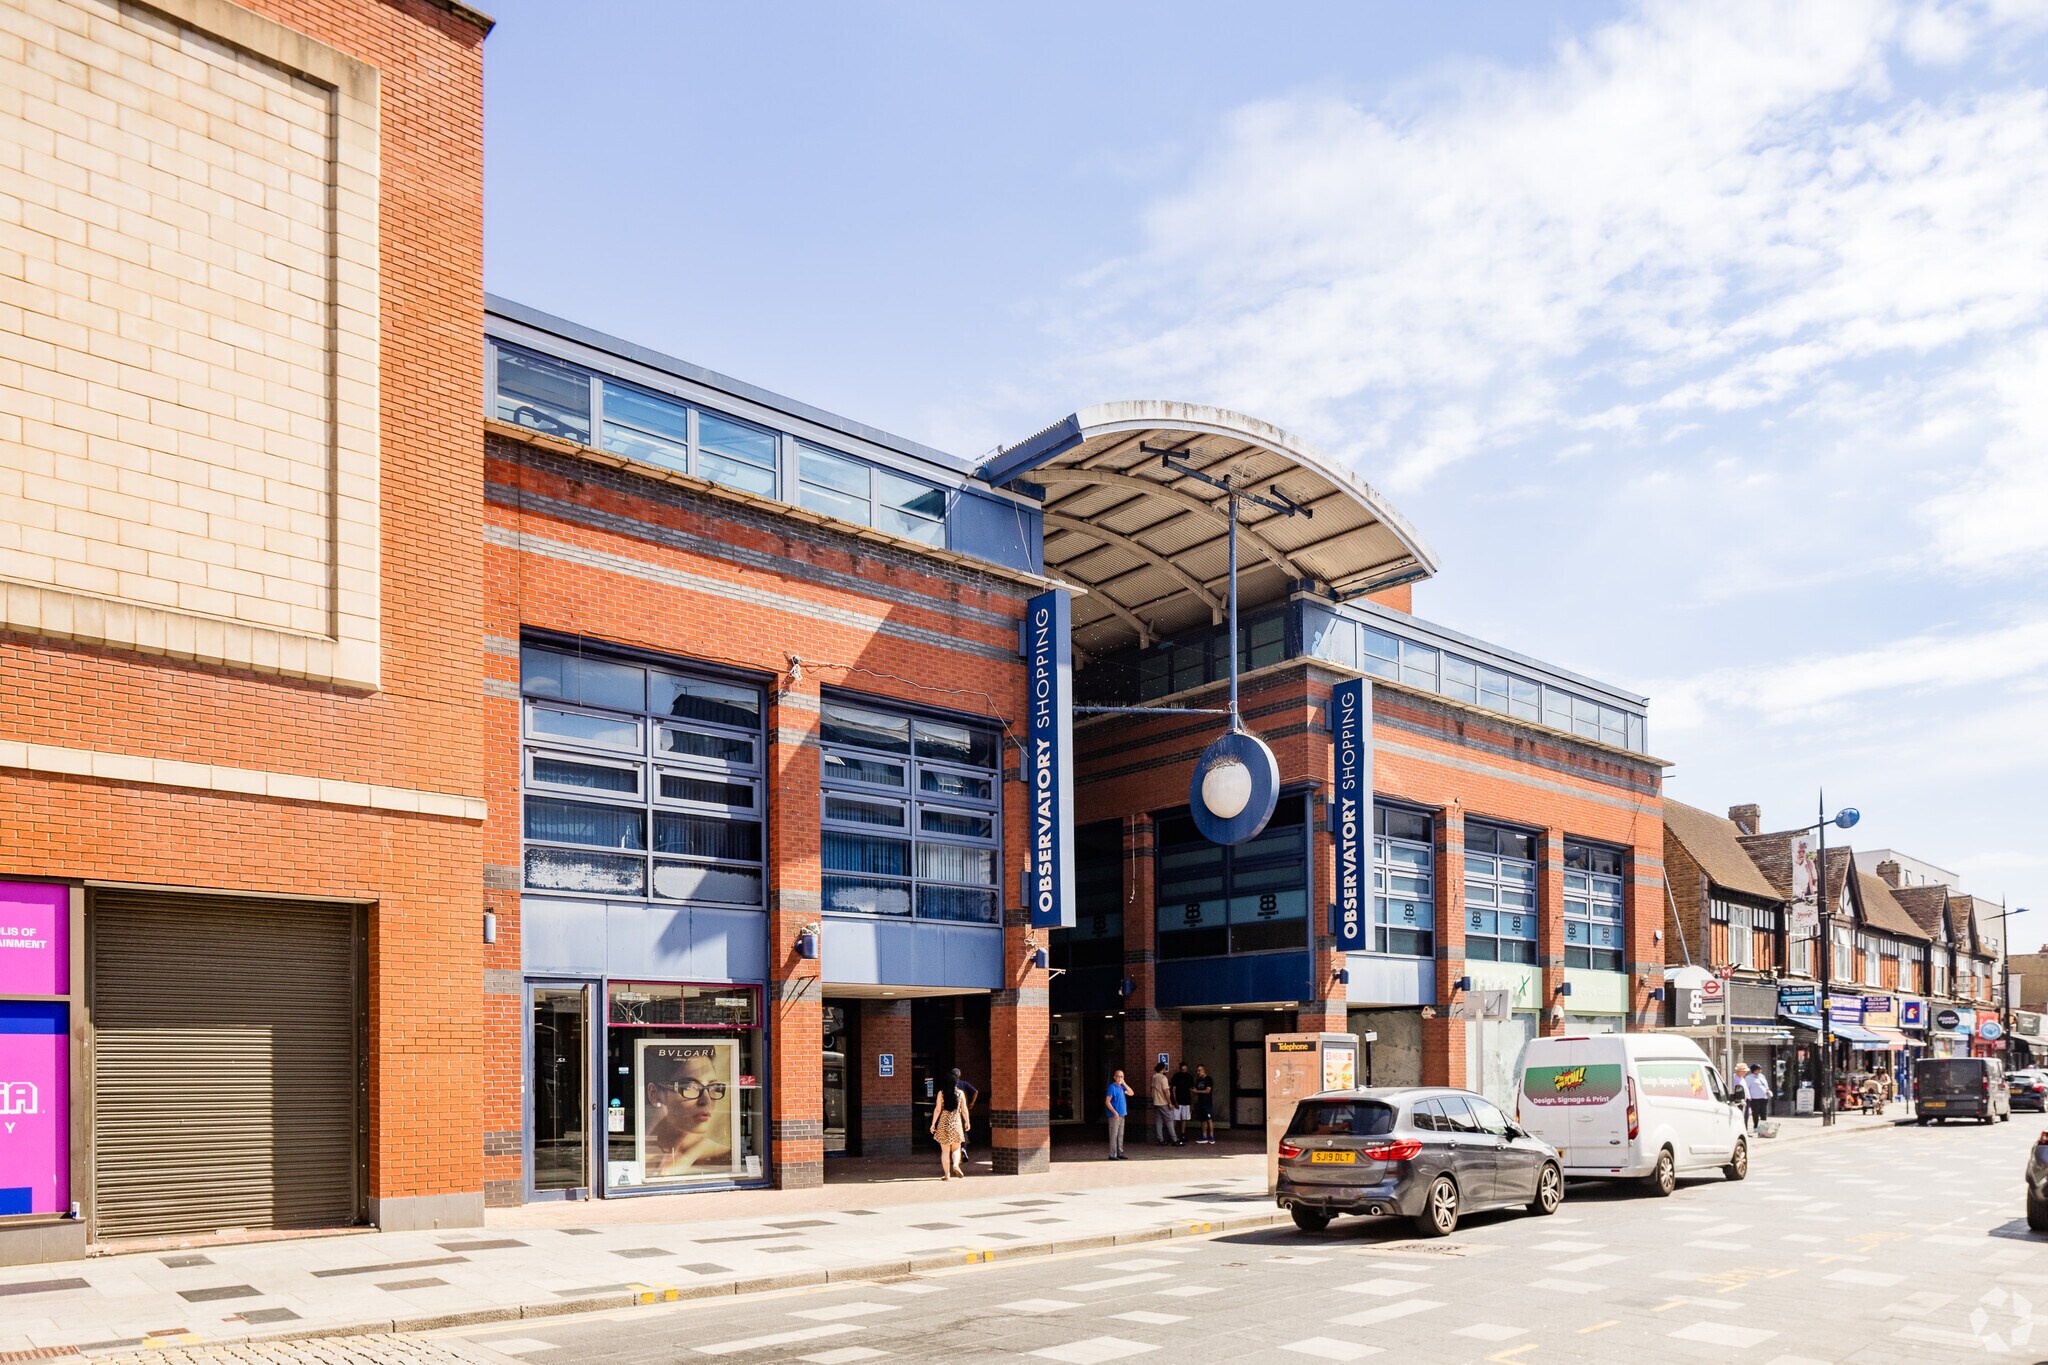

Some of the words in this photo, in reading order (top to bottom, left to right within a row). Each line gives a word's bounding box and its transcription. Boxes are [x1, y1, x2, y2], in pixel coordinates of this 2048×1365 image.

[1036, 608, 1050, 728] SHOPPING
[1341, 692, 1355, 790] SHOPPING
[1037, 738, 1052, 912] OBSERVATORY
[1342, 797, 1357, 939] OBSERVATORY
[0, 927, 19, 936] LIS
[21, 927, 37, 937] OF
[1277, 1042, 1309, 1052] Telephone
[658, 1049, 715, 1057] BVLGARI
[1533, 1097, 1557, 1105] Design,
[1557, 1096, 1585, 1105] Signage
[1316, 1153, 1333, 1161] SJ19
[1335, 1153, 1350, 1161] DLT
